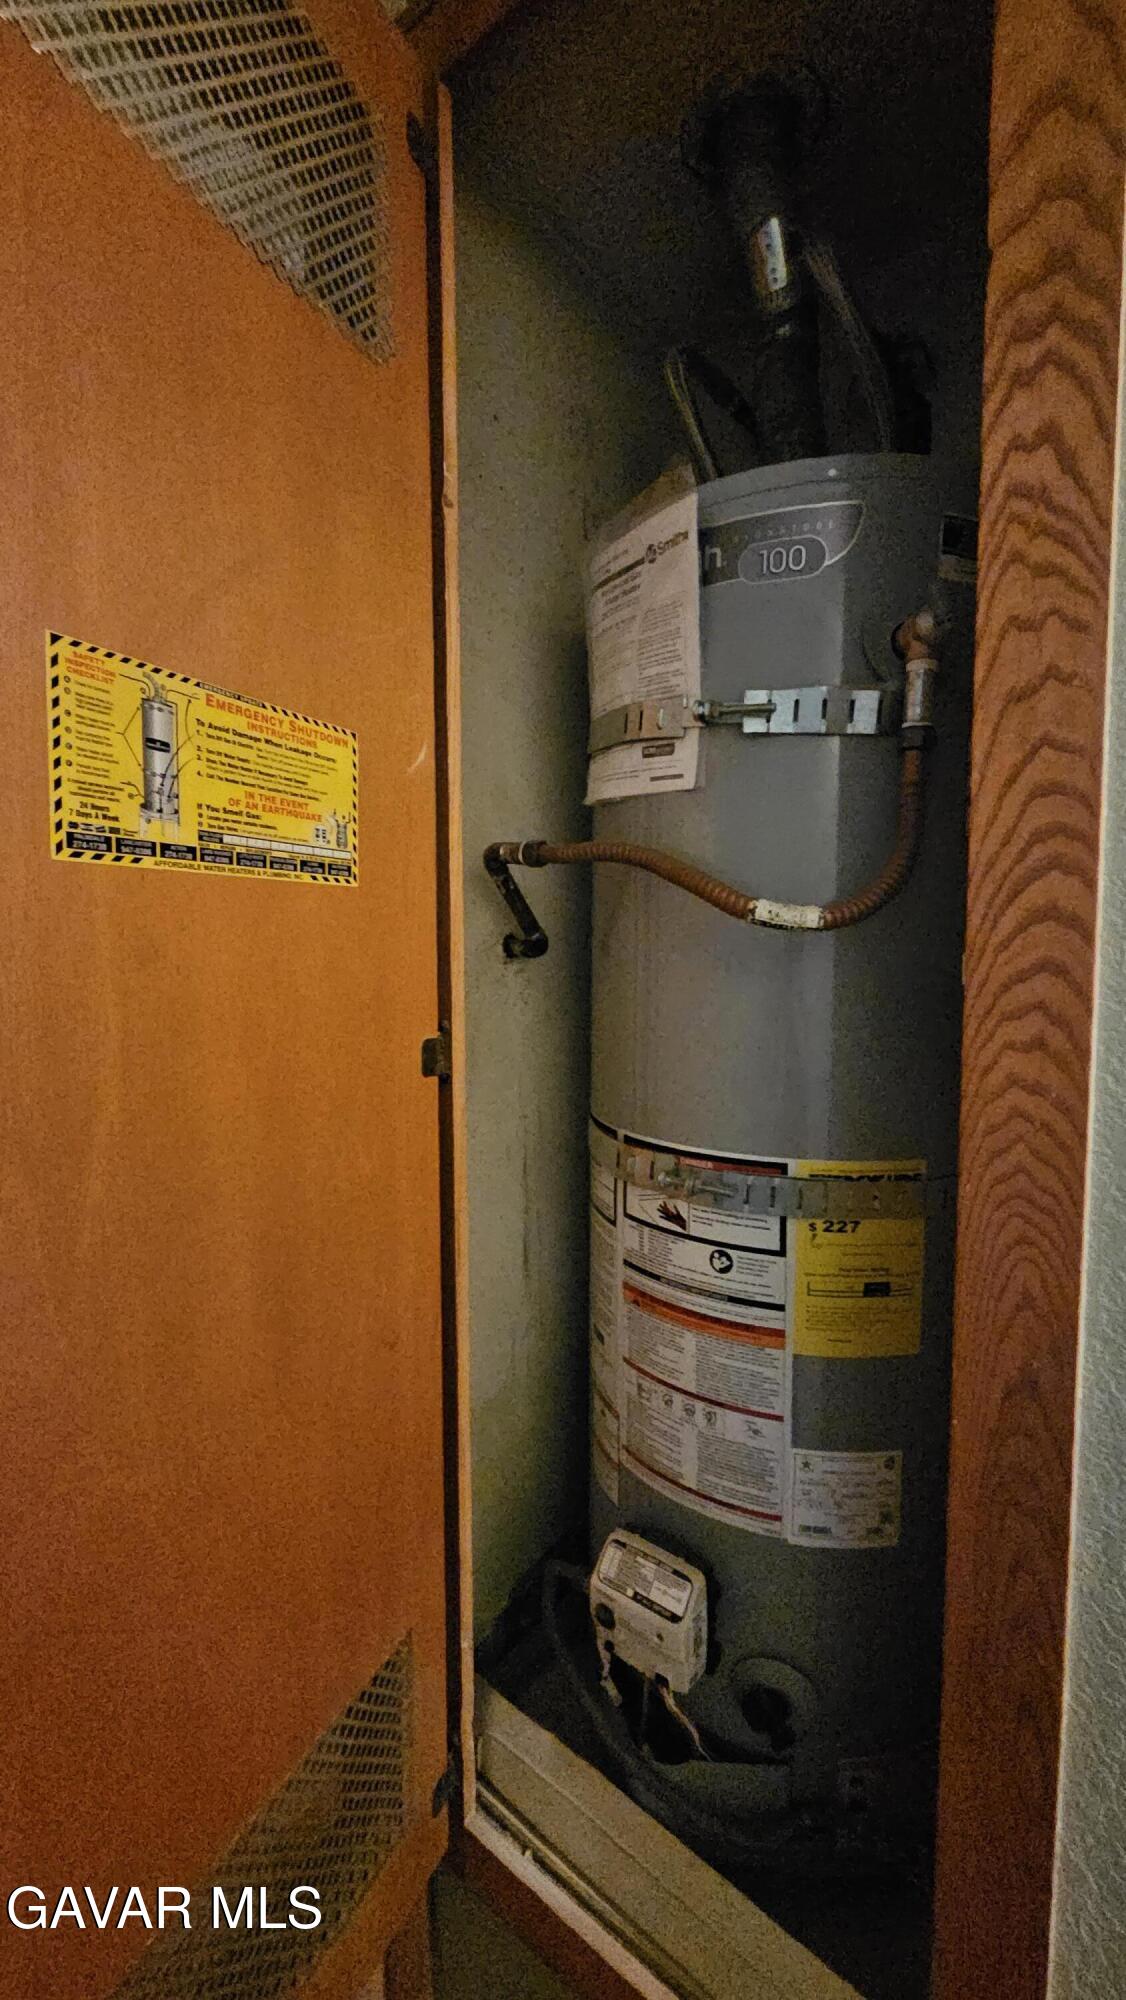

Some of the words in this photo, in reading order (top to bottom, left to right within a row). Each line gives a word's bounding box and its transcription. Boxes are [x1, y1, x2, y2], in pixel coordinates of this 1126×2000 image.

[760, 545, 806, 574] 100
[66, 666, 115, 685] CHECKLIST
[205, 693, 285, 728] EMERGENCY
[288, 720, 350, 748] SHUTDOWN
[196, 718, 205, 727] To
[208, 721, 230, 734] Avoid
[232, 729, 262, 743] Damage
[264, 737, 283, 748] When
[285, 744, 312, 758] Leakage
[247, 722, 317, 748] INSTRUCTIONS
[90, 803, 110, 812] Hours
[206, 804, 220, 813] You
[222, 807, 243, 817] Smell
[228, 798, 241, 807] OF
[245, 801, 258, 811] AN
[262, 804, 322, 822] EARTHQUAKE
[244, 791, 255, 800] IN
[258, 793, 276, 804] THE
[280, 798, 309, 811] EVENT
[69, 808, 73, 816] 7
[76, 810, 93, 819] Days
[102, 814, 120, 822] Week
[153, 860, 202, 871] AFFORDABLE
[204, 865, 226, 873] WATER
[227, 867, 256, 876] HEATERS
[822, 1219, 861, 1233] 227
